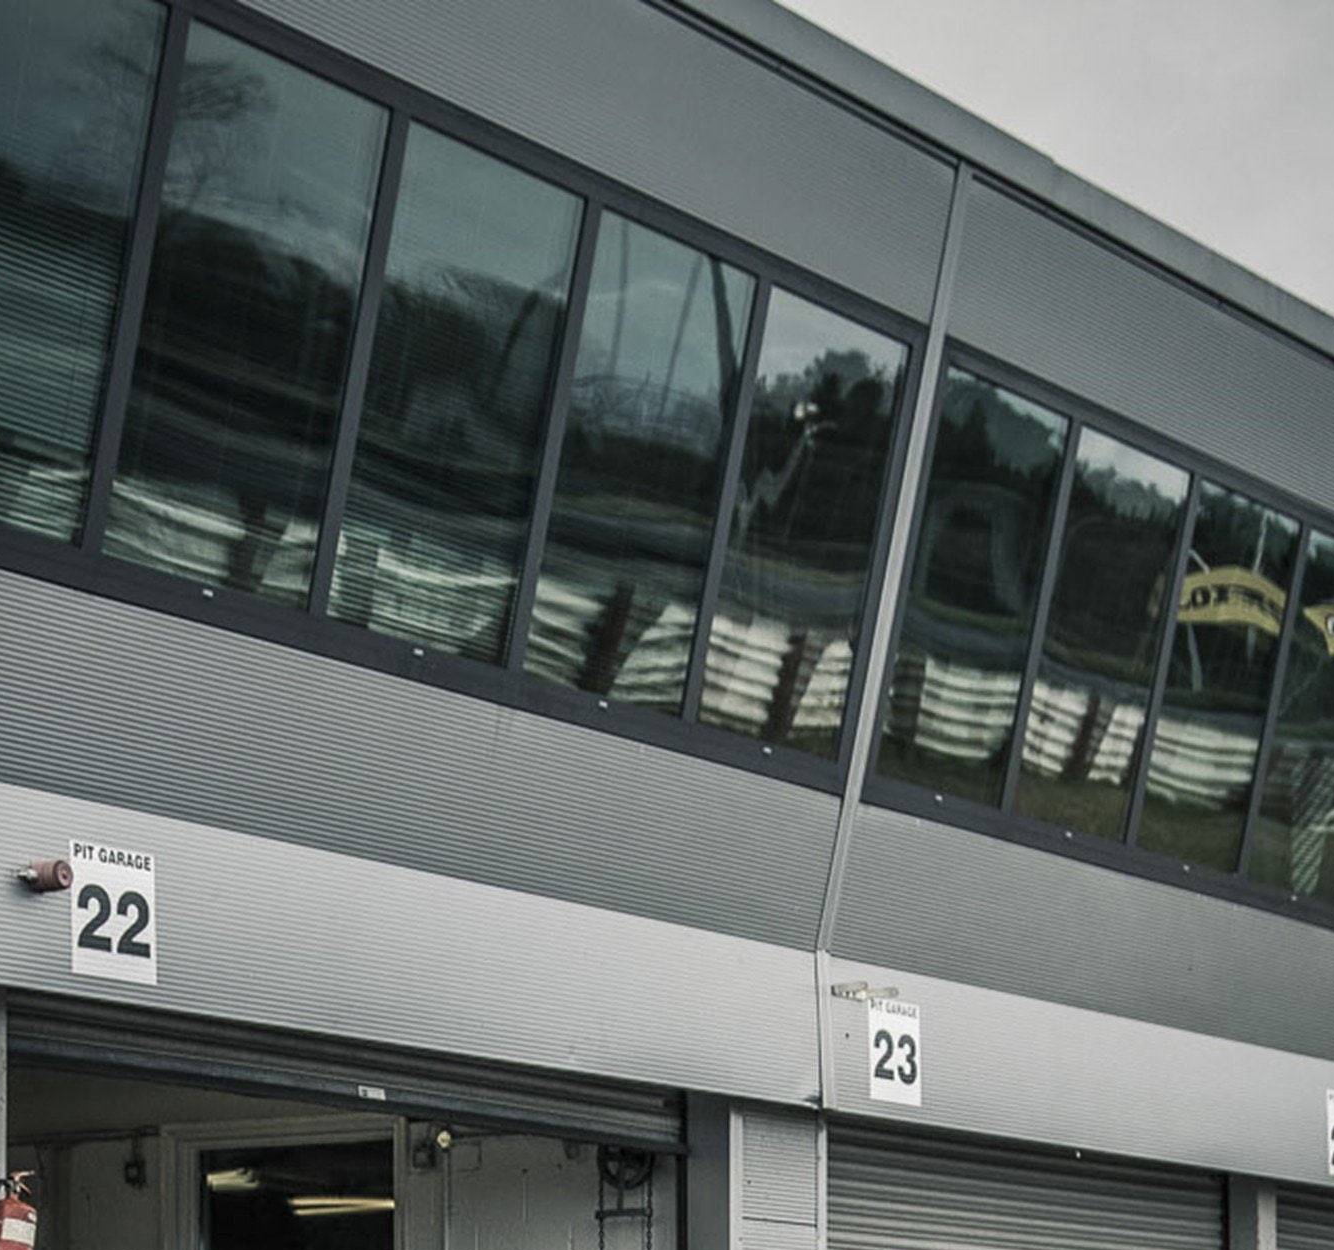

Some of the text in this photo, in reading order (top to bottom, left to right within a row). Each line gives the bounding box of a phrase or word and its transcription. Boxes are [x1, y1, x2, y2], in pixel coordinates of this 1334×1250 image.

[73, 843, 152, 871] PIT GARAGE
[77, 883, 151, 959] 22
[873, 1029, 918, 1085] 23
